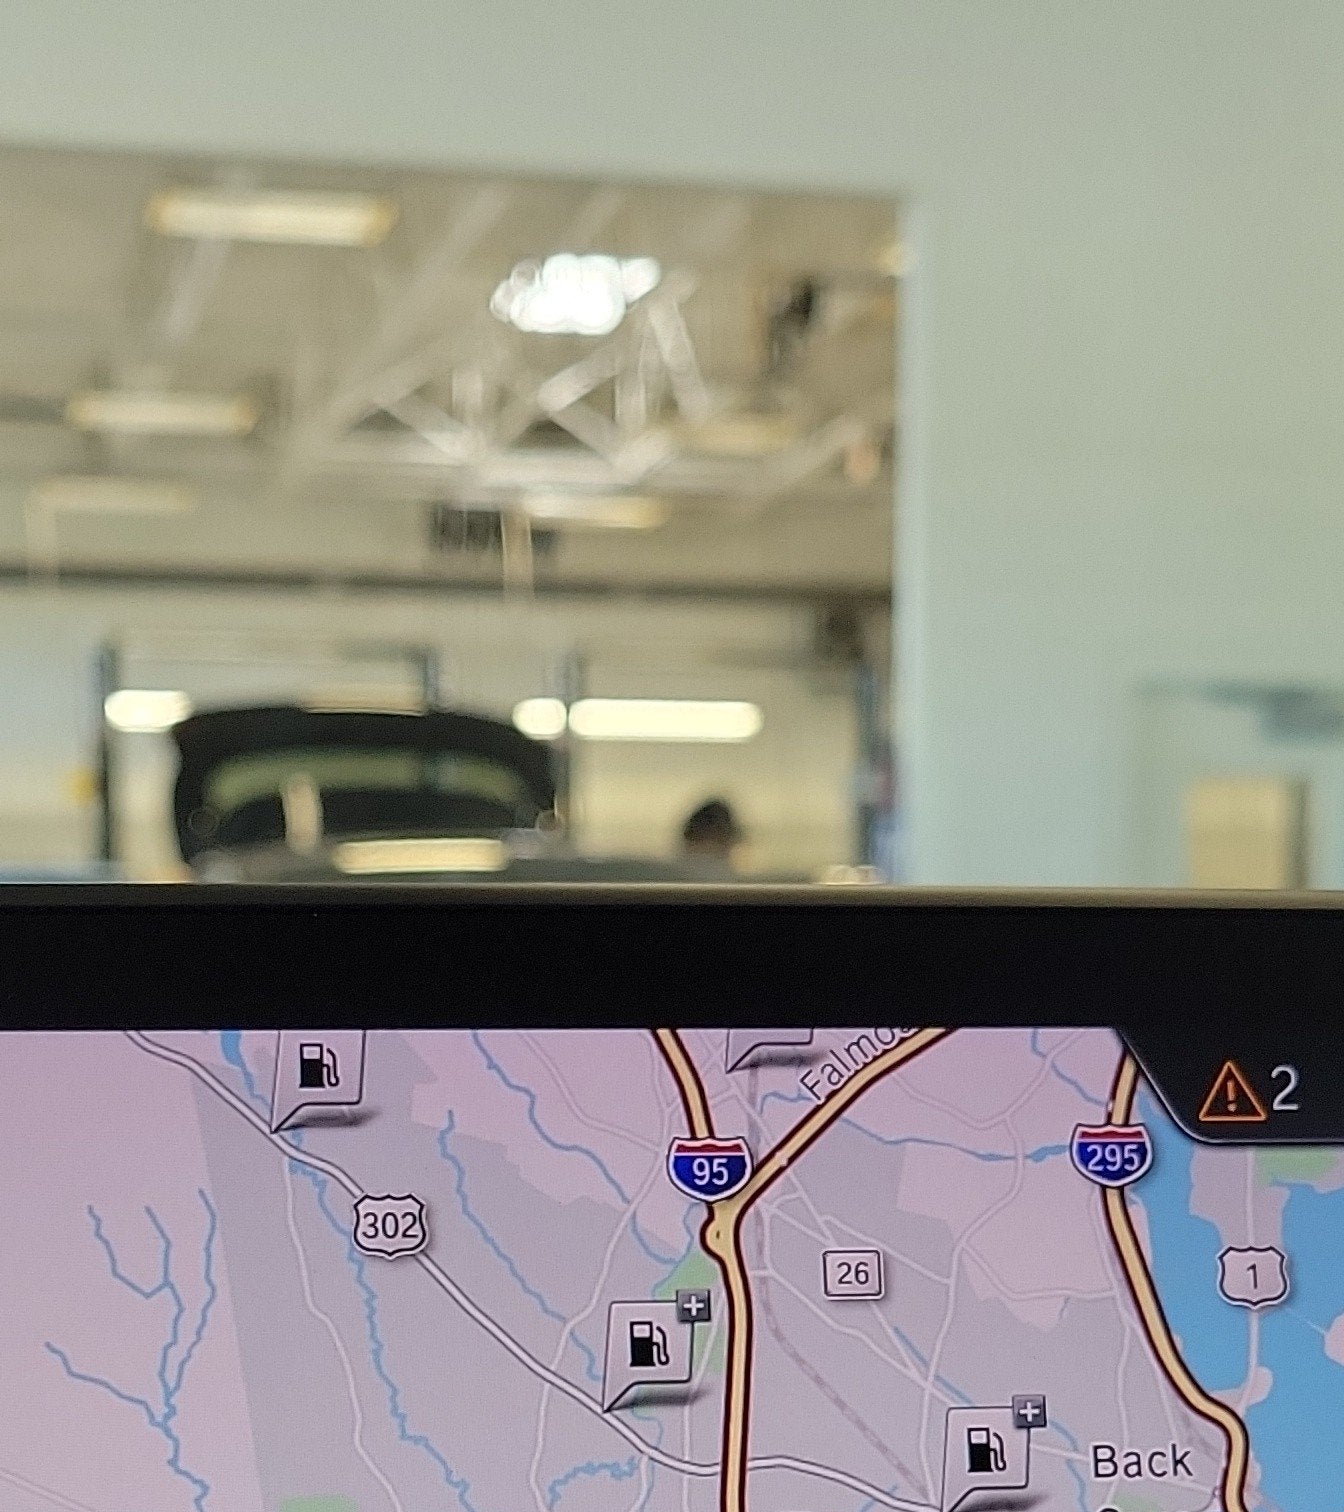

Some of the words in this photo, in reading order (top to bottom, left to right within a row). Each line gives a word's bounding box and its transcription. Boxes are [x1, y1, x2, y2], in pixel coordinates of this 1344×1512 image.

[799, 1027, 914, 1101] Falmo
[1271, 1067, 1300, 1111] 2
[692, 1157, 729, 1186] 95
[1086, 1143, 1141, 1172] 295
[361, 1210, 419, 1241] 302
[836, 1261, 869, 1286] 26
[1246, 1263, 1258, 1288] 1
[1092, 1444, 1193, 1479] Back
